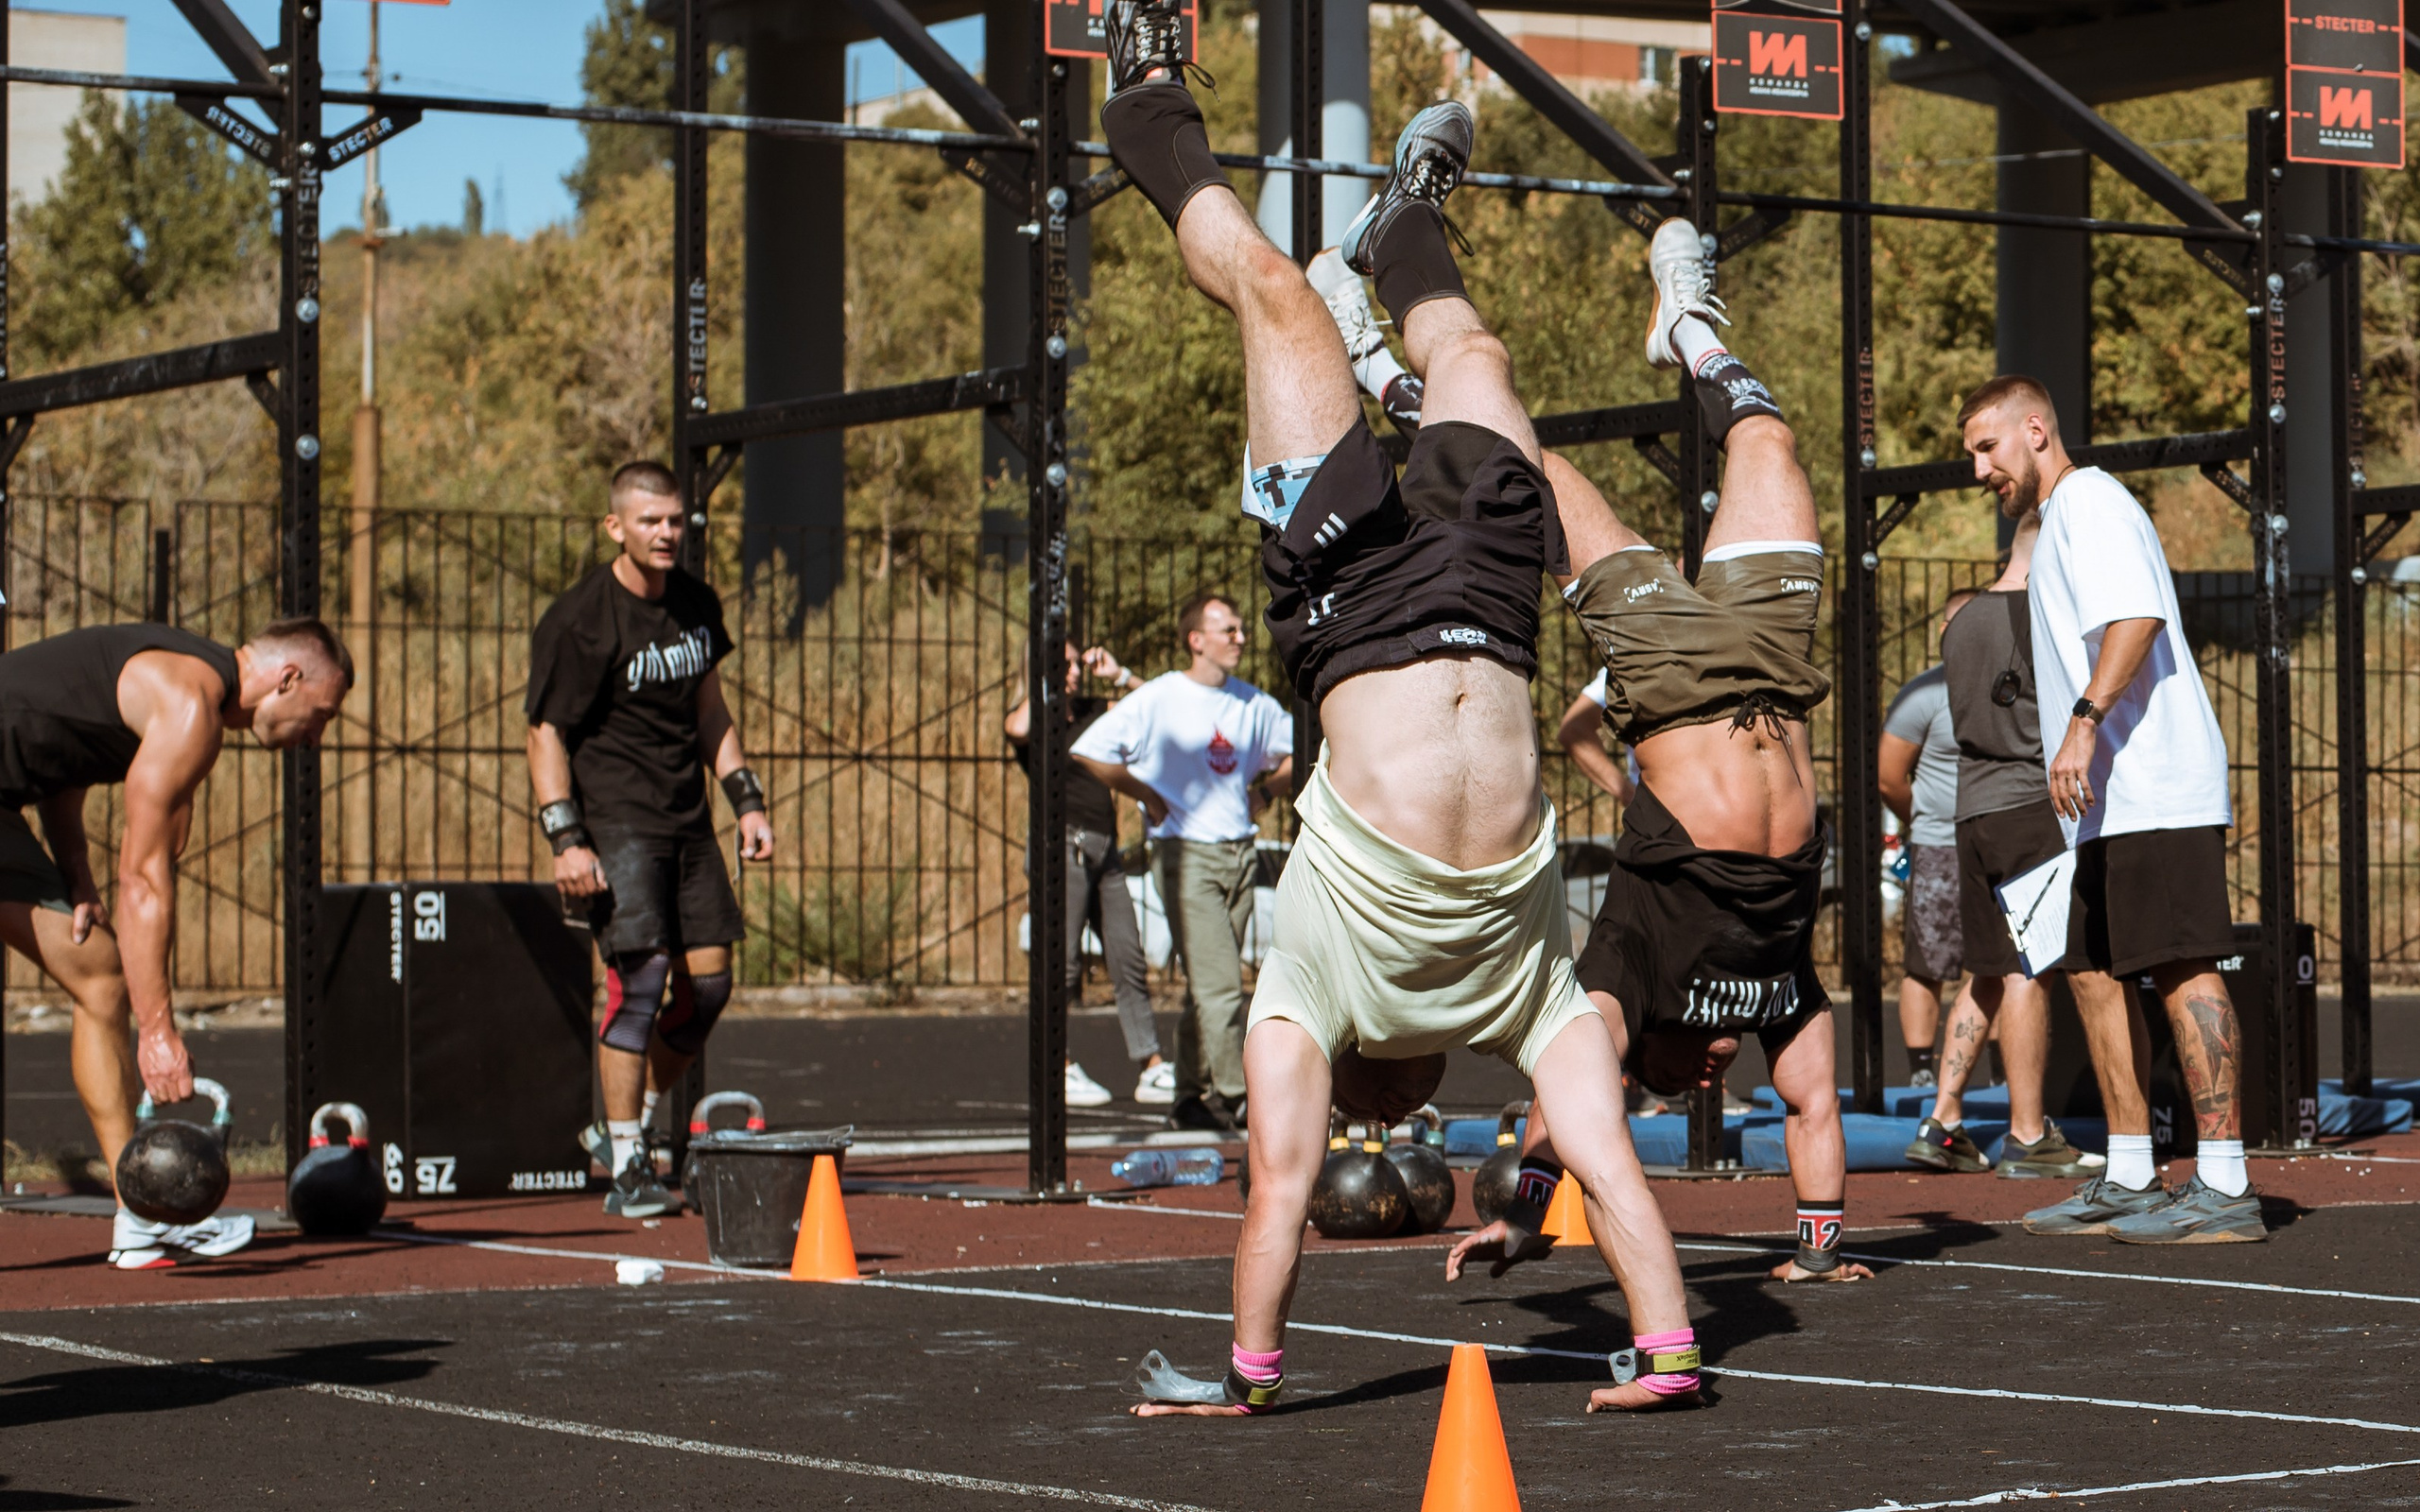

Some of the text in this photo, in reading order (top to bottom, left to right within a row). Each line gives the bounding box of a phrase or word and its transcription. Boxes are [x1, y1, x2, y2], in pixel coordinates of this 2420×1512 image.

[2315, 14, 2376, 34] STECTER
[327, 116, 394, 162] STECTER
[1048, 215, 1066, 331] STECTER
[2270, 298, 2286, 400] STECTER
[1858, 352, 1874, 446] STECTER
[1629, 578, 1660, 600] ASRV
[1784, 578, 1817, 593] ASRV
[390, 891, 402, 981] STECTER
[414, 891, 442, 940] 50
[2296, 954, 2313, 980] 0
[2154, 1107, 2172, 1144] 75
[2298, 1098, 2316, 1139] 50
[384, 1143, 404, 1194] 60
[415, 1160, 457, 1194] 75
[510, 1170, 586, 1191] STECTER
